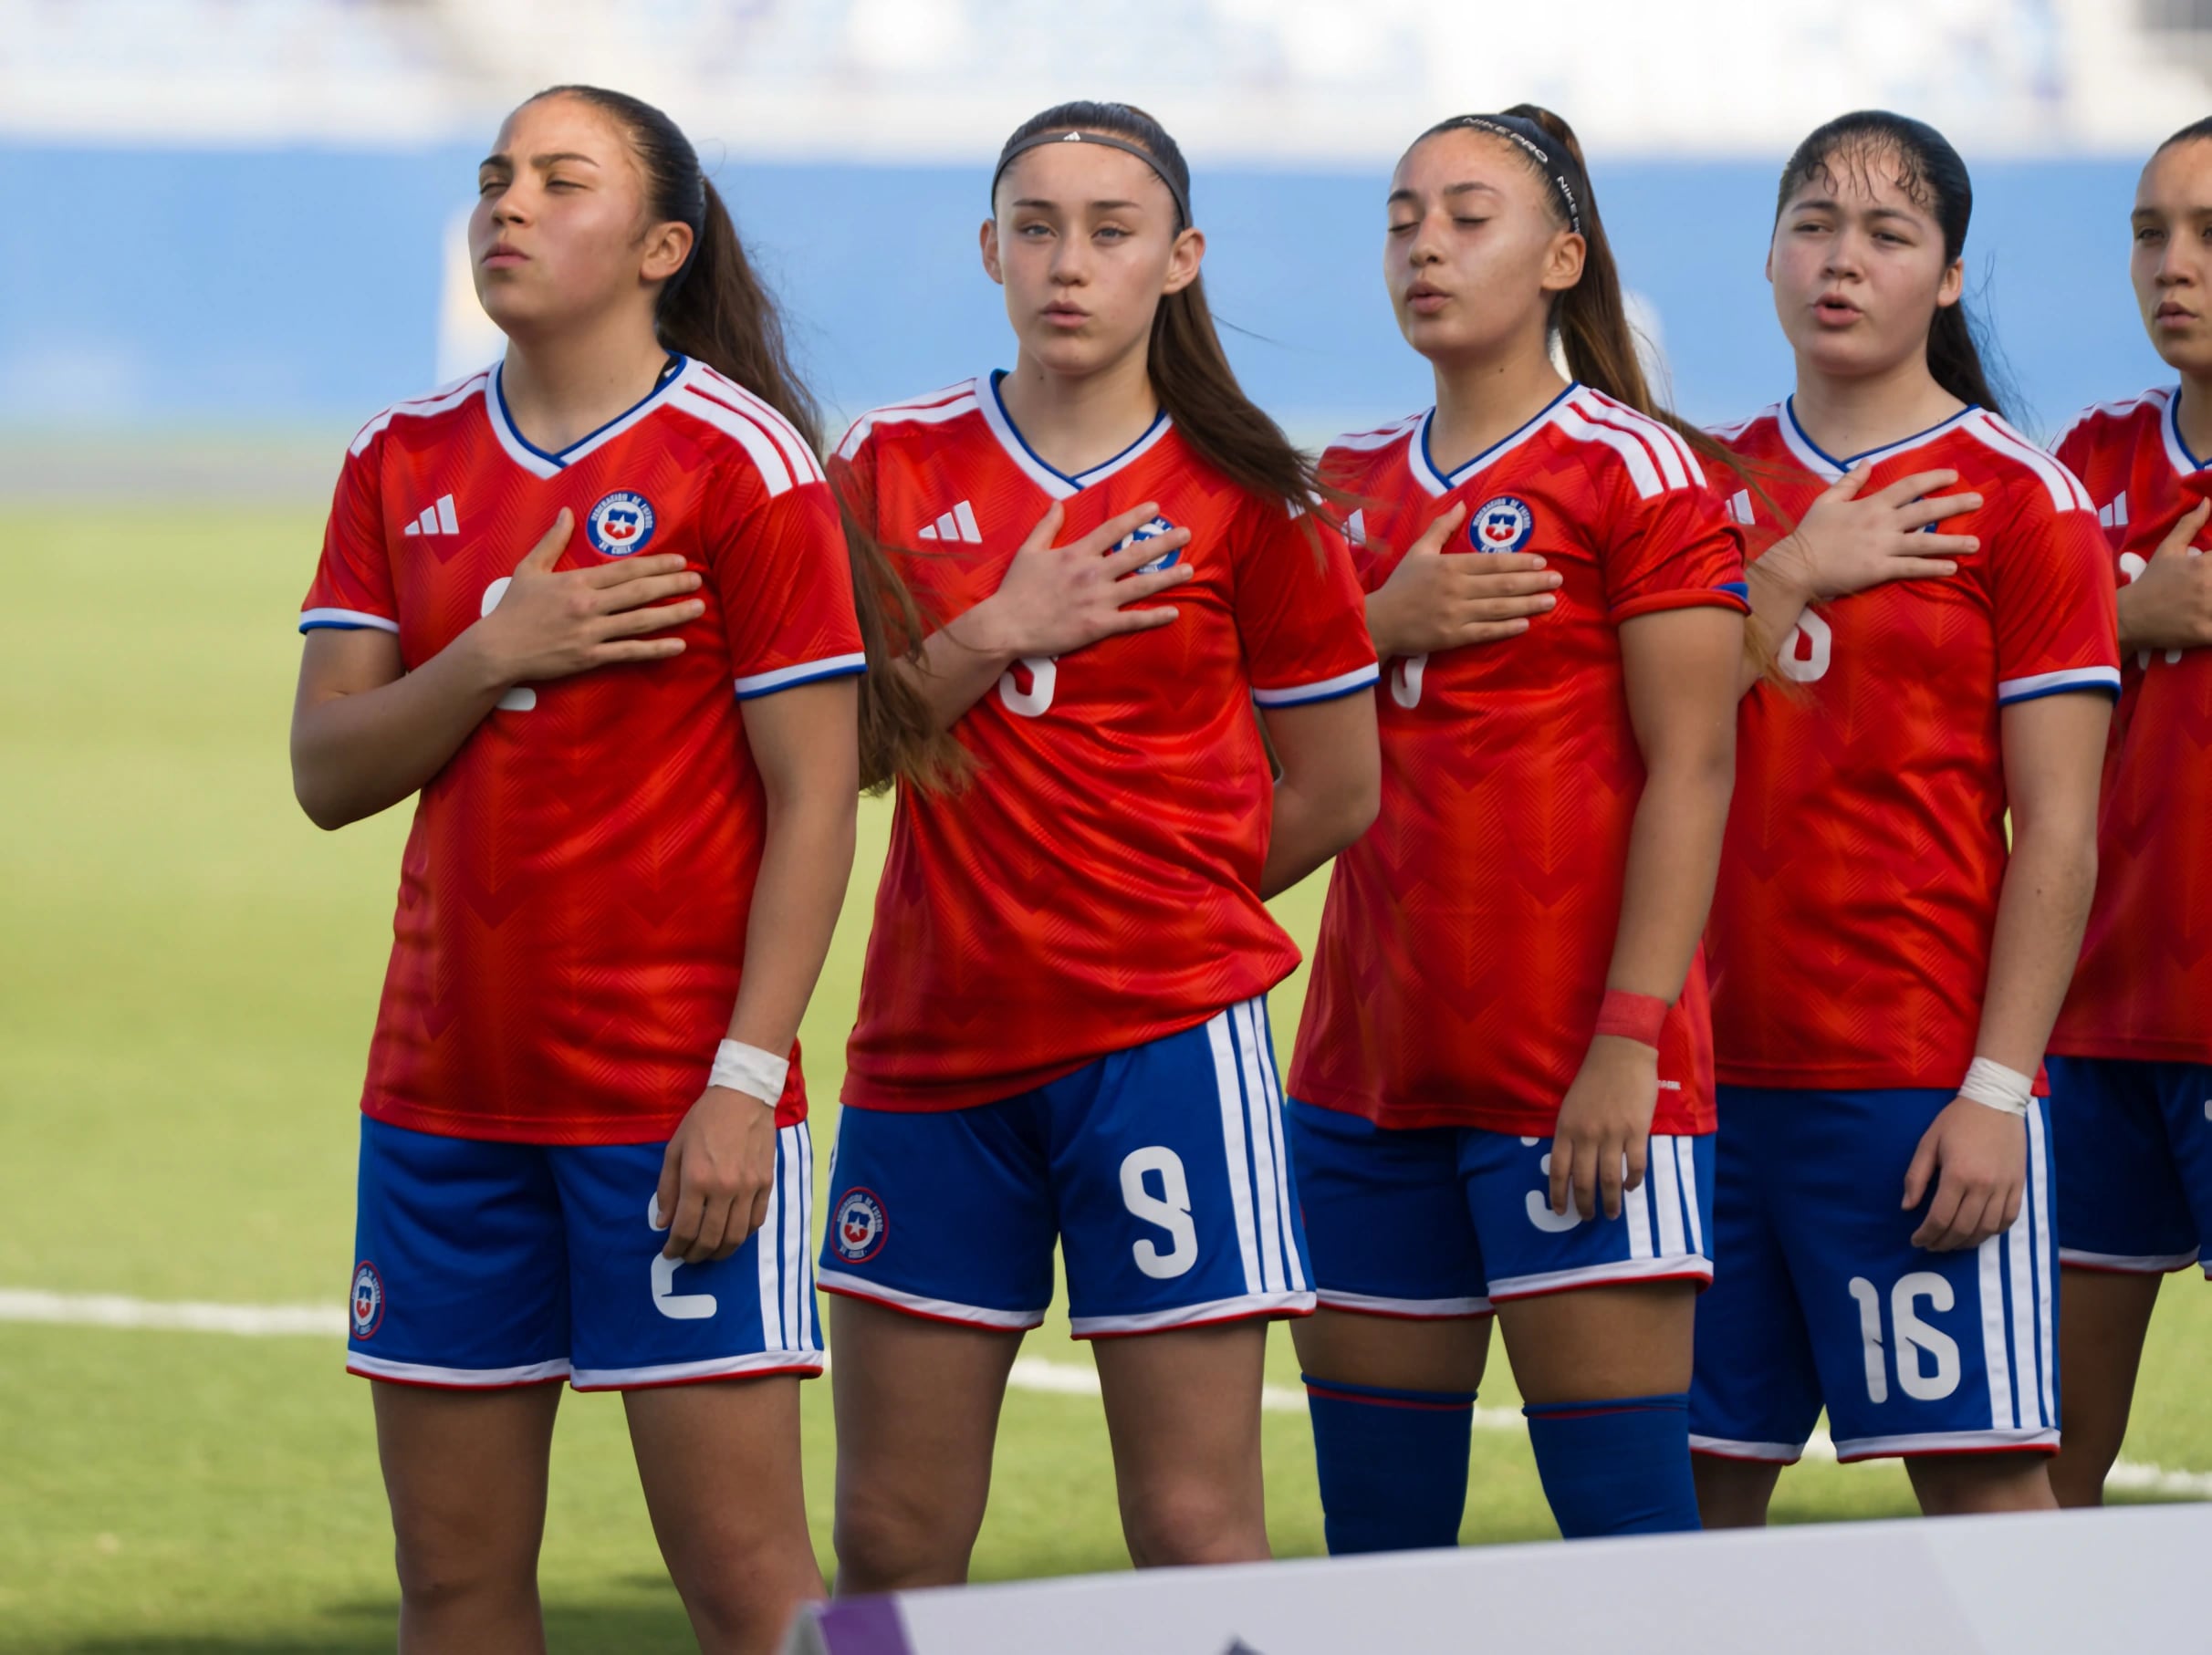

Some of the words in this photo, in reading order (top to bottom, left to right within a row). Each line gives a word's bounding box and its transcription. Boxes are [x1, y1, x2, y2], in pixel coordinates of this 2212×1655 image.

[1462, 117, 1511, 135] NIKE
[1510, 132, 1549, 164] PRO
[1556, 175, 1578, 216] NIKE
[1119, 1145, 1199, 1280] 9
[1848, 1271, 1962, 1405] 16
